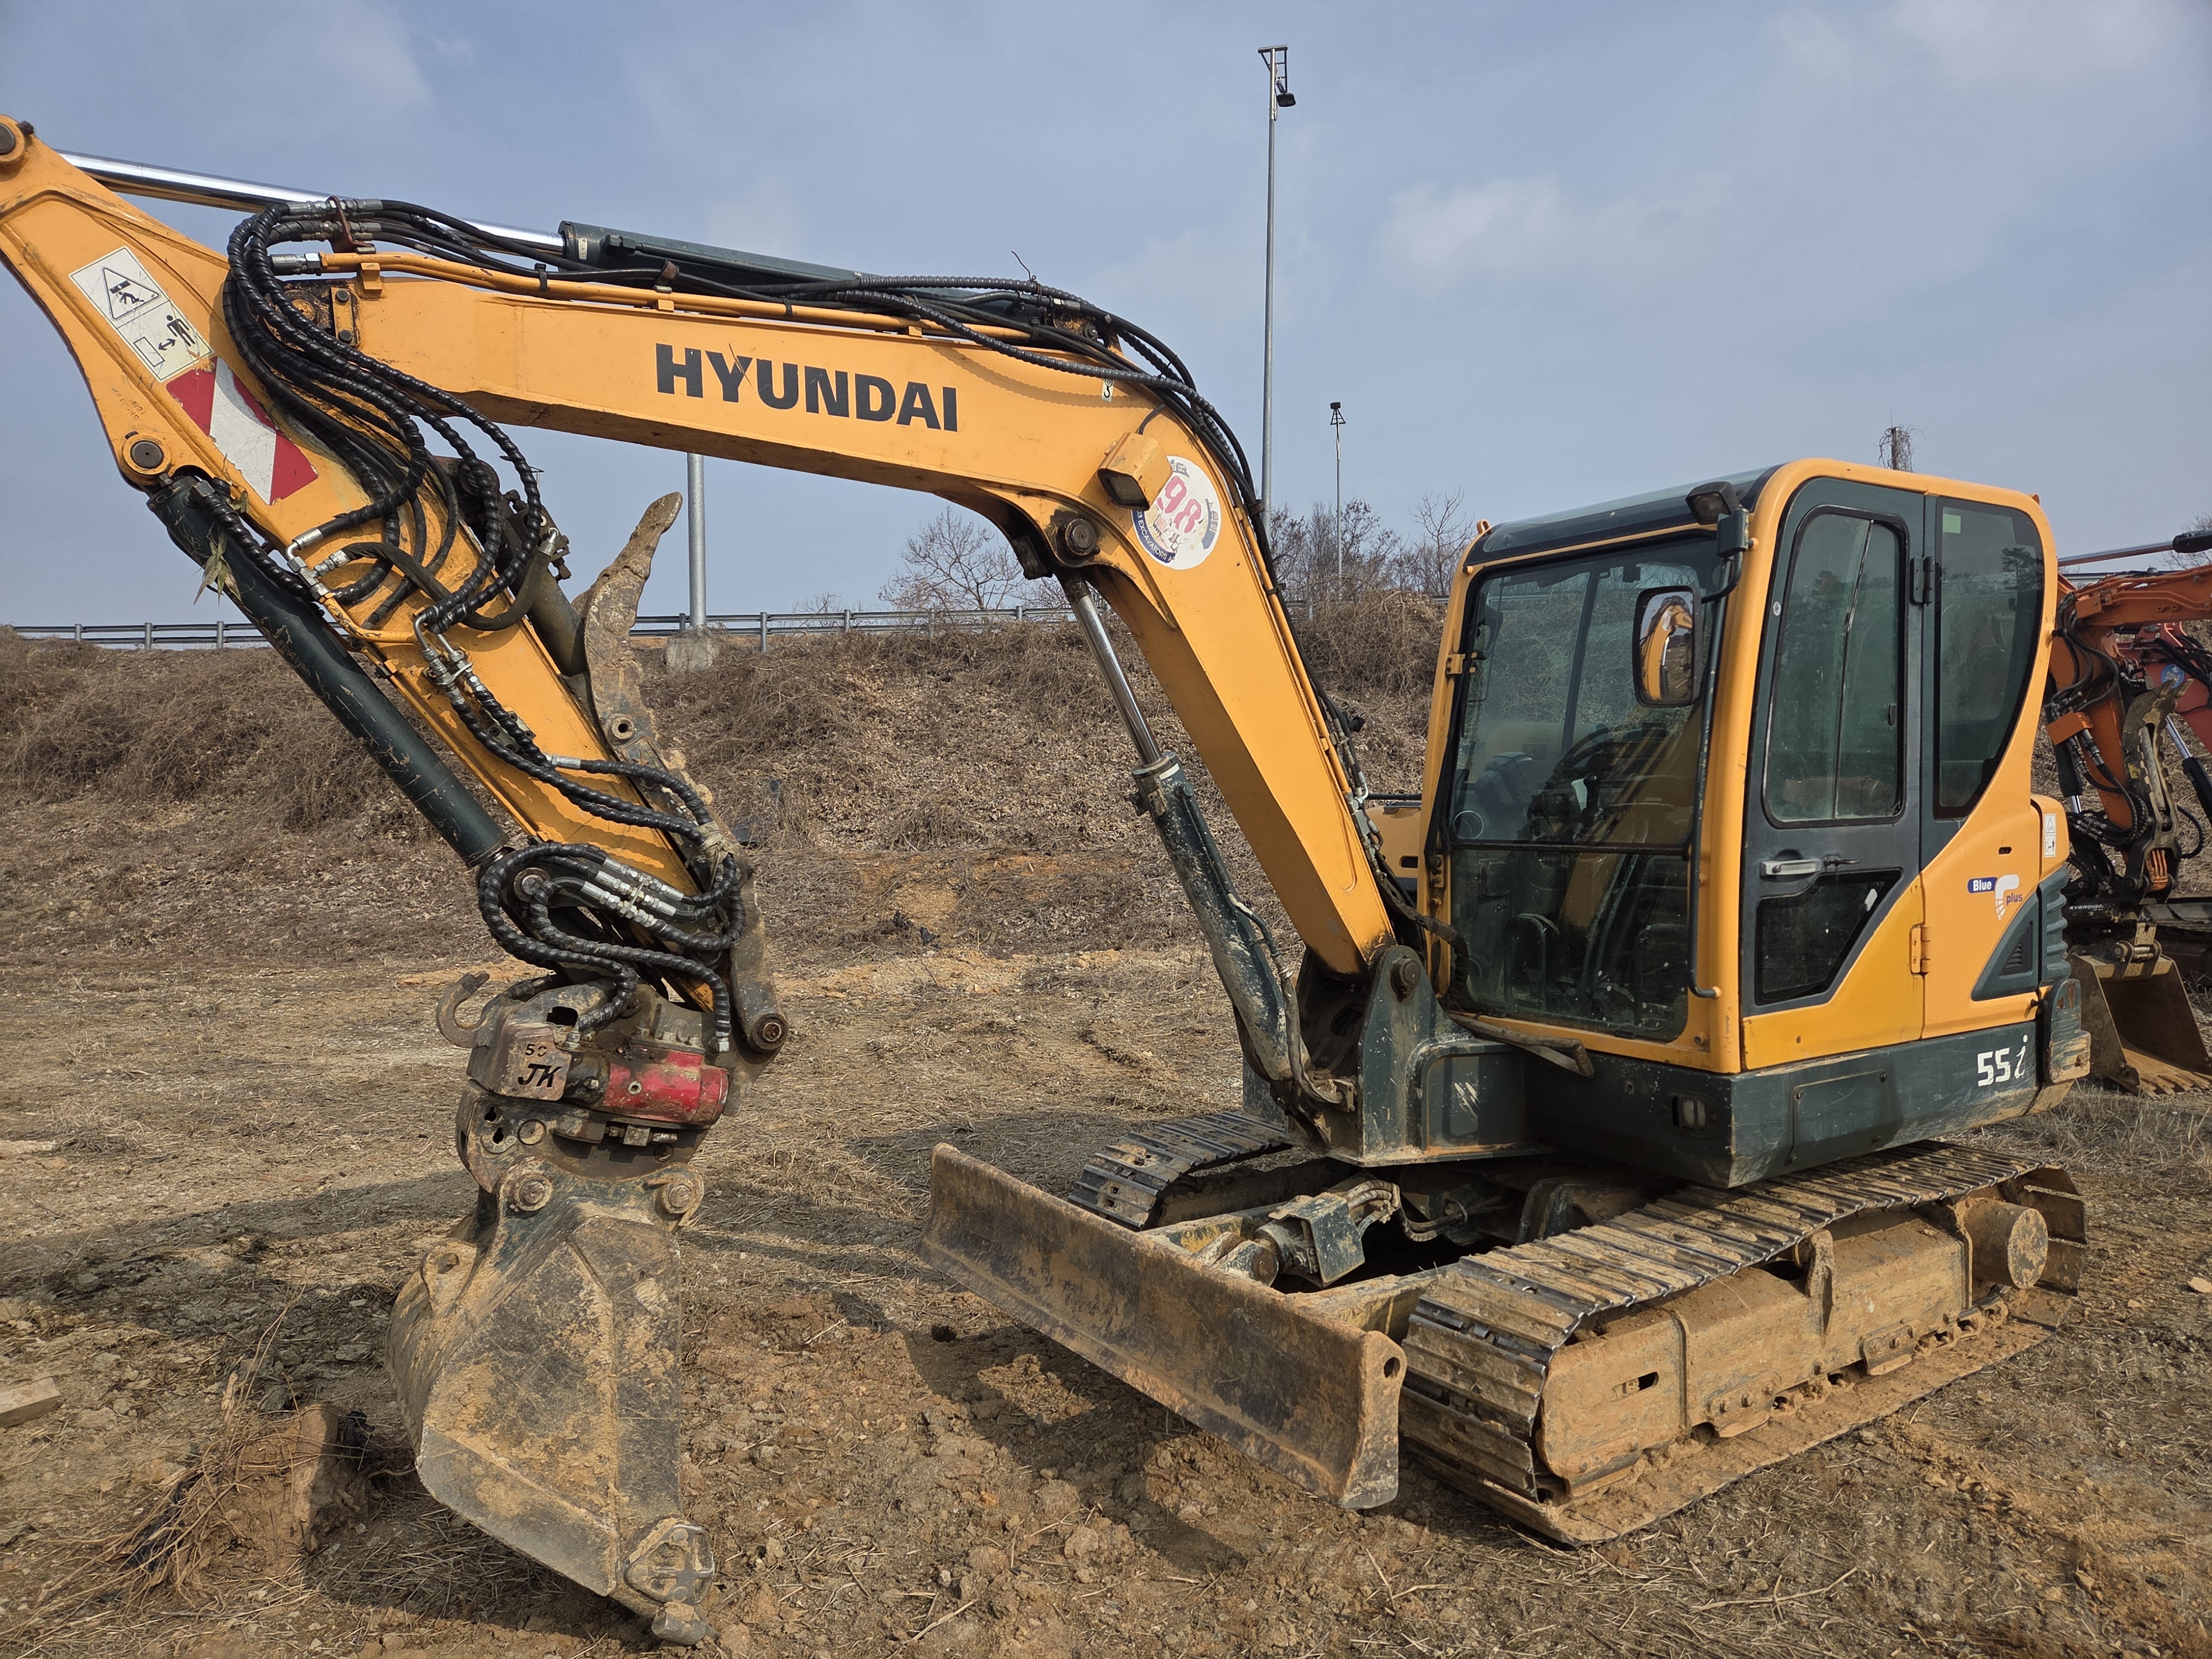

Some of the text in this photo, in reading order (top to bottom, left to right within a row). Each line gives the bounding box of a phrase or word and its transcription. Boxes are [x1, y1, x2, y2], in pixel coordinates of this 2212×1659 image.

[655, 343, 958, 432] HYUNDAI
[1138, 519, 1167, 560] EXCAVATORS
[1973, 879, 1992, 891] Blue
[2006, 892, 2023, 906] plus
[517, 1063, 563, 1088] JK
